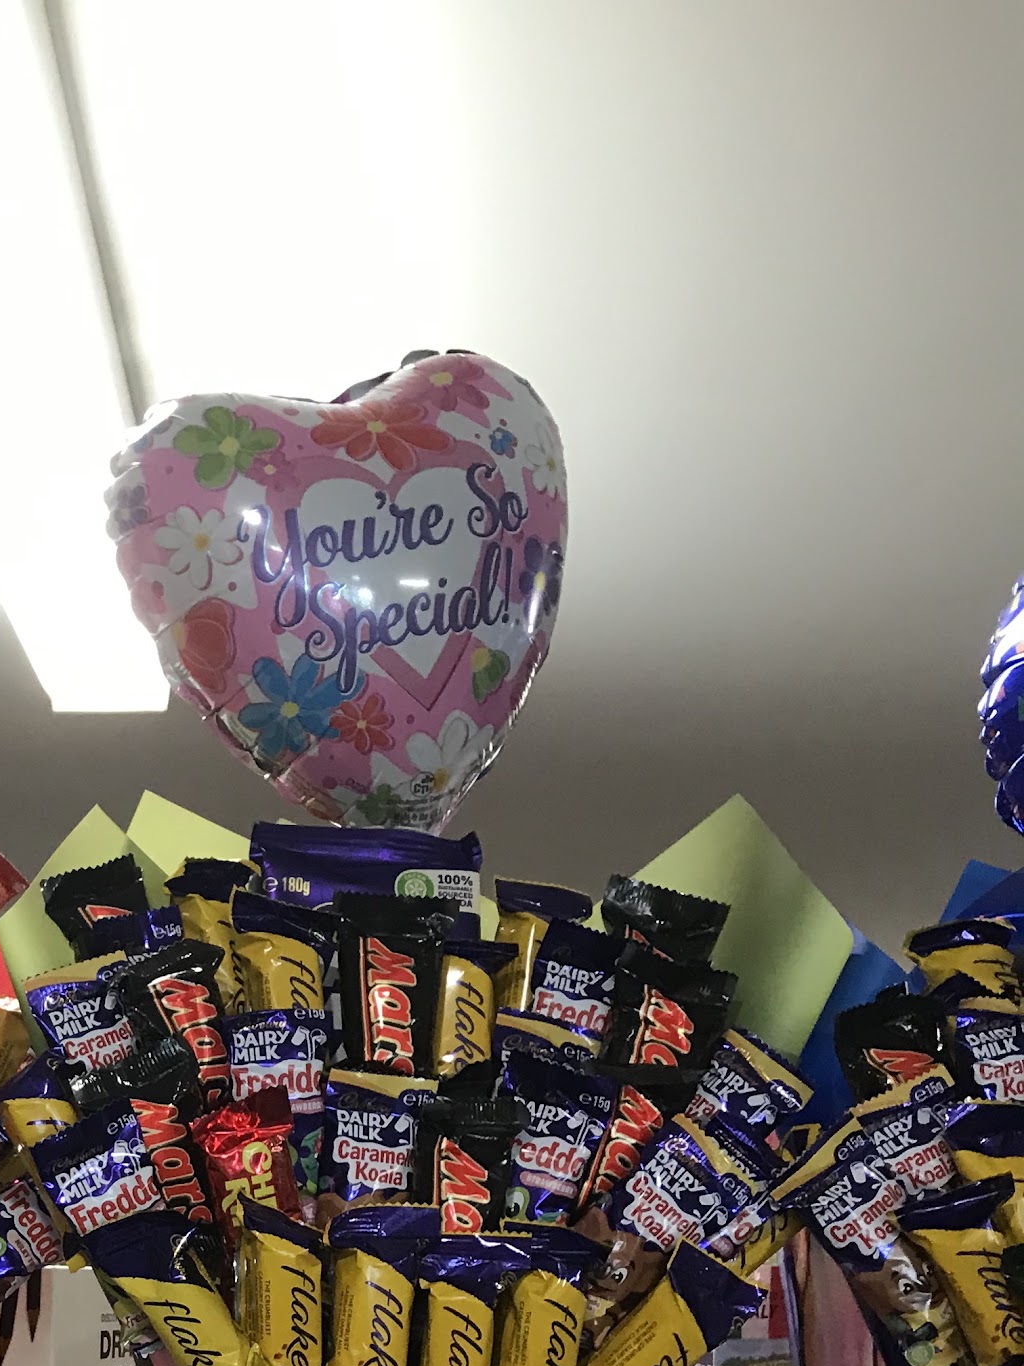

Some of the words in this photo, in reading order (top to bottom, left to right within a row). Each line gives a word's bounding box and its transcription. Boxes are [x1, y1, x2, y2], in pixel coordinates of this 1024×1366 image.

[236, 491, 454, 627] You're
[465, 462, 529, 538] So
[305, 542, 513, 694] Special!
[281, 876, 311, 895] 180g
[437, 874, 474, 887] 100%
[279, 955, 320, 1010] Fla
[542, 972, 588, 997] MILK
[546, 960, 603, 984] DAIRY
[48, 996, 102, 1028] DAIRY
[535, 991, 612, 1036] Fredd
[56, 1017, 102, 1042] MILK
[232, 1030, 290, 1048] DAIRY
[964, 1026, 1018, 1047] DAIRY
[233, 1046, 281, 1063] MILK
[973, 1038, 1020, 1060] MILK
[336, 1109, 393, 1129] DAIRY
[337, 1123, 383, 1141] MILK
[54, 1152, 111, 1190] DAIRY
[63, 1168, 110, 1203] MILK
[355, 1161, 403, 1186] Koala
[440, 1136, 491, 1233] Ma
[645, 1159, 682, 1199] MILK
[656, 1148, 707, 1193] DAIRY
[631, 1174, 702, 1244] Caramello
[631, 1201, 676, 1248] Koala
[815, 1192, 862, 1227] MILK
[829, 1184, 904, 1243] Caramello
[858, 1219, 897, 1250] Koa
